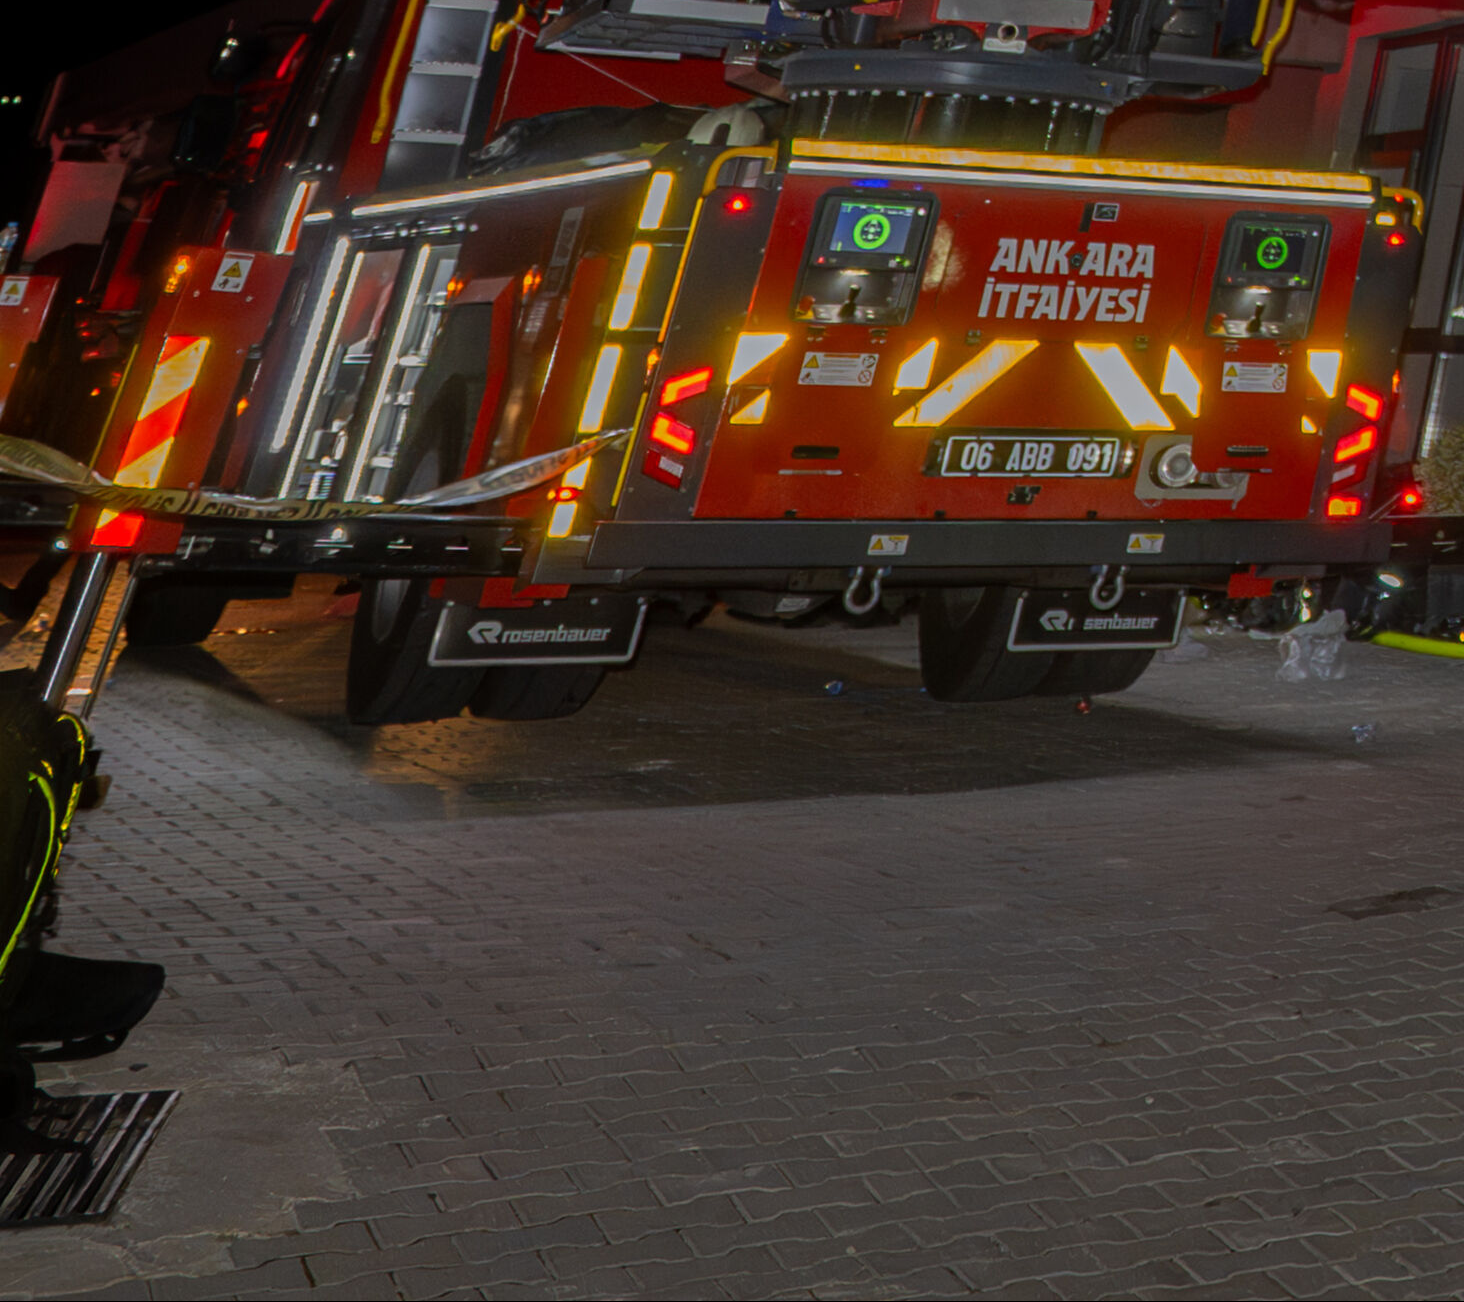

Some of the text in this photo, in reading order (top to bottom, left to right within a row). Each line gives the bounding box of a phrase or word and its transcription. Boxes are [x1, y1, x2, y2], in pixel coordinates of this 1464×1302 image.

[977, 276, 1152, 324] İTFAİYESİ
[960, 442, 1114, 472] 06 ABB 091
[501, 623, 612, 644] rosenbauer
